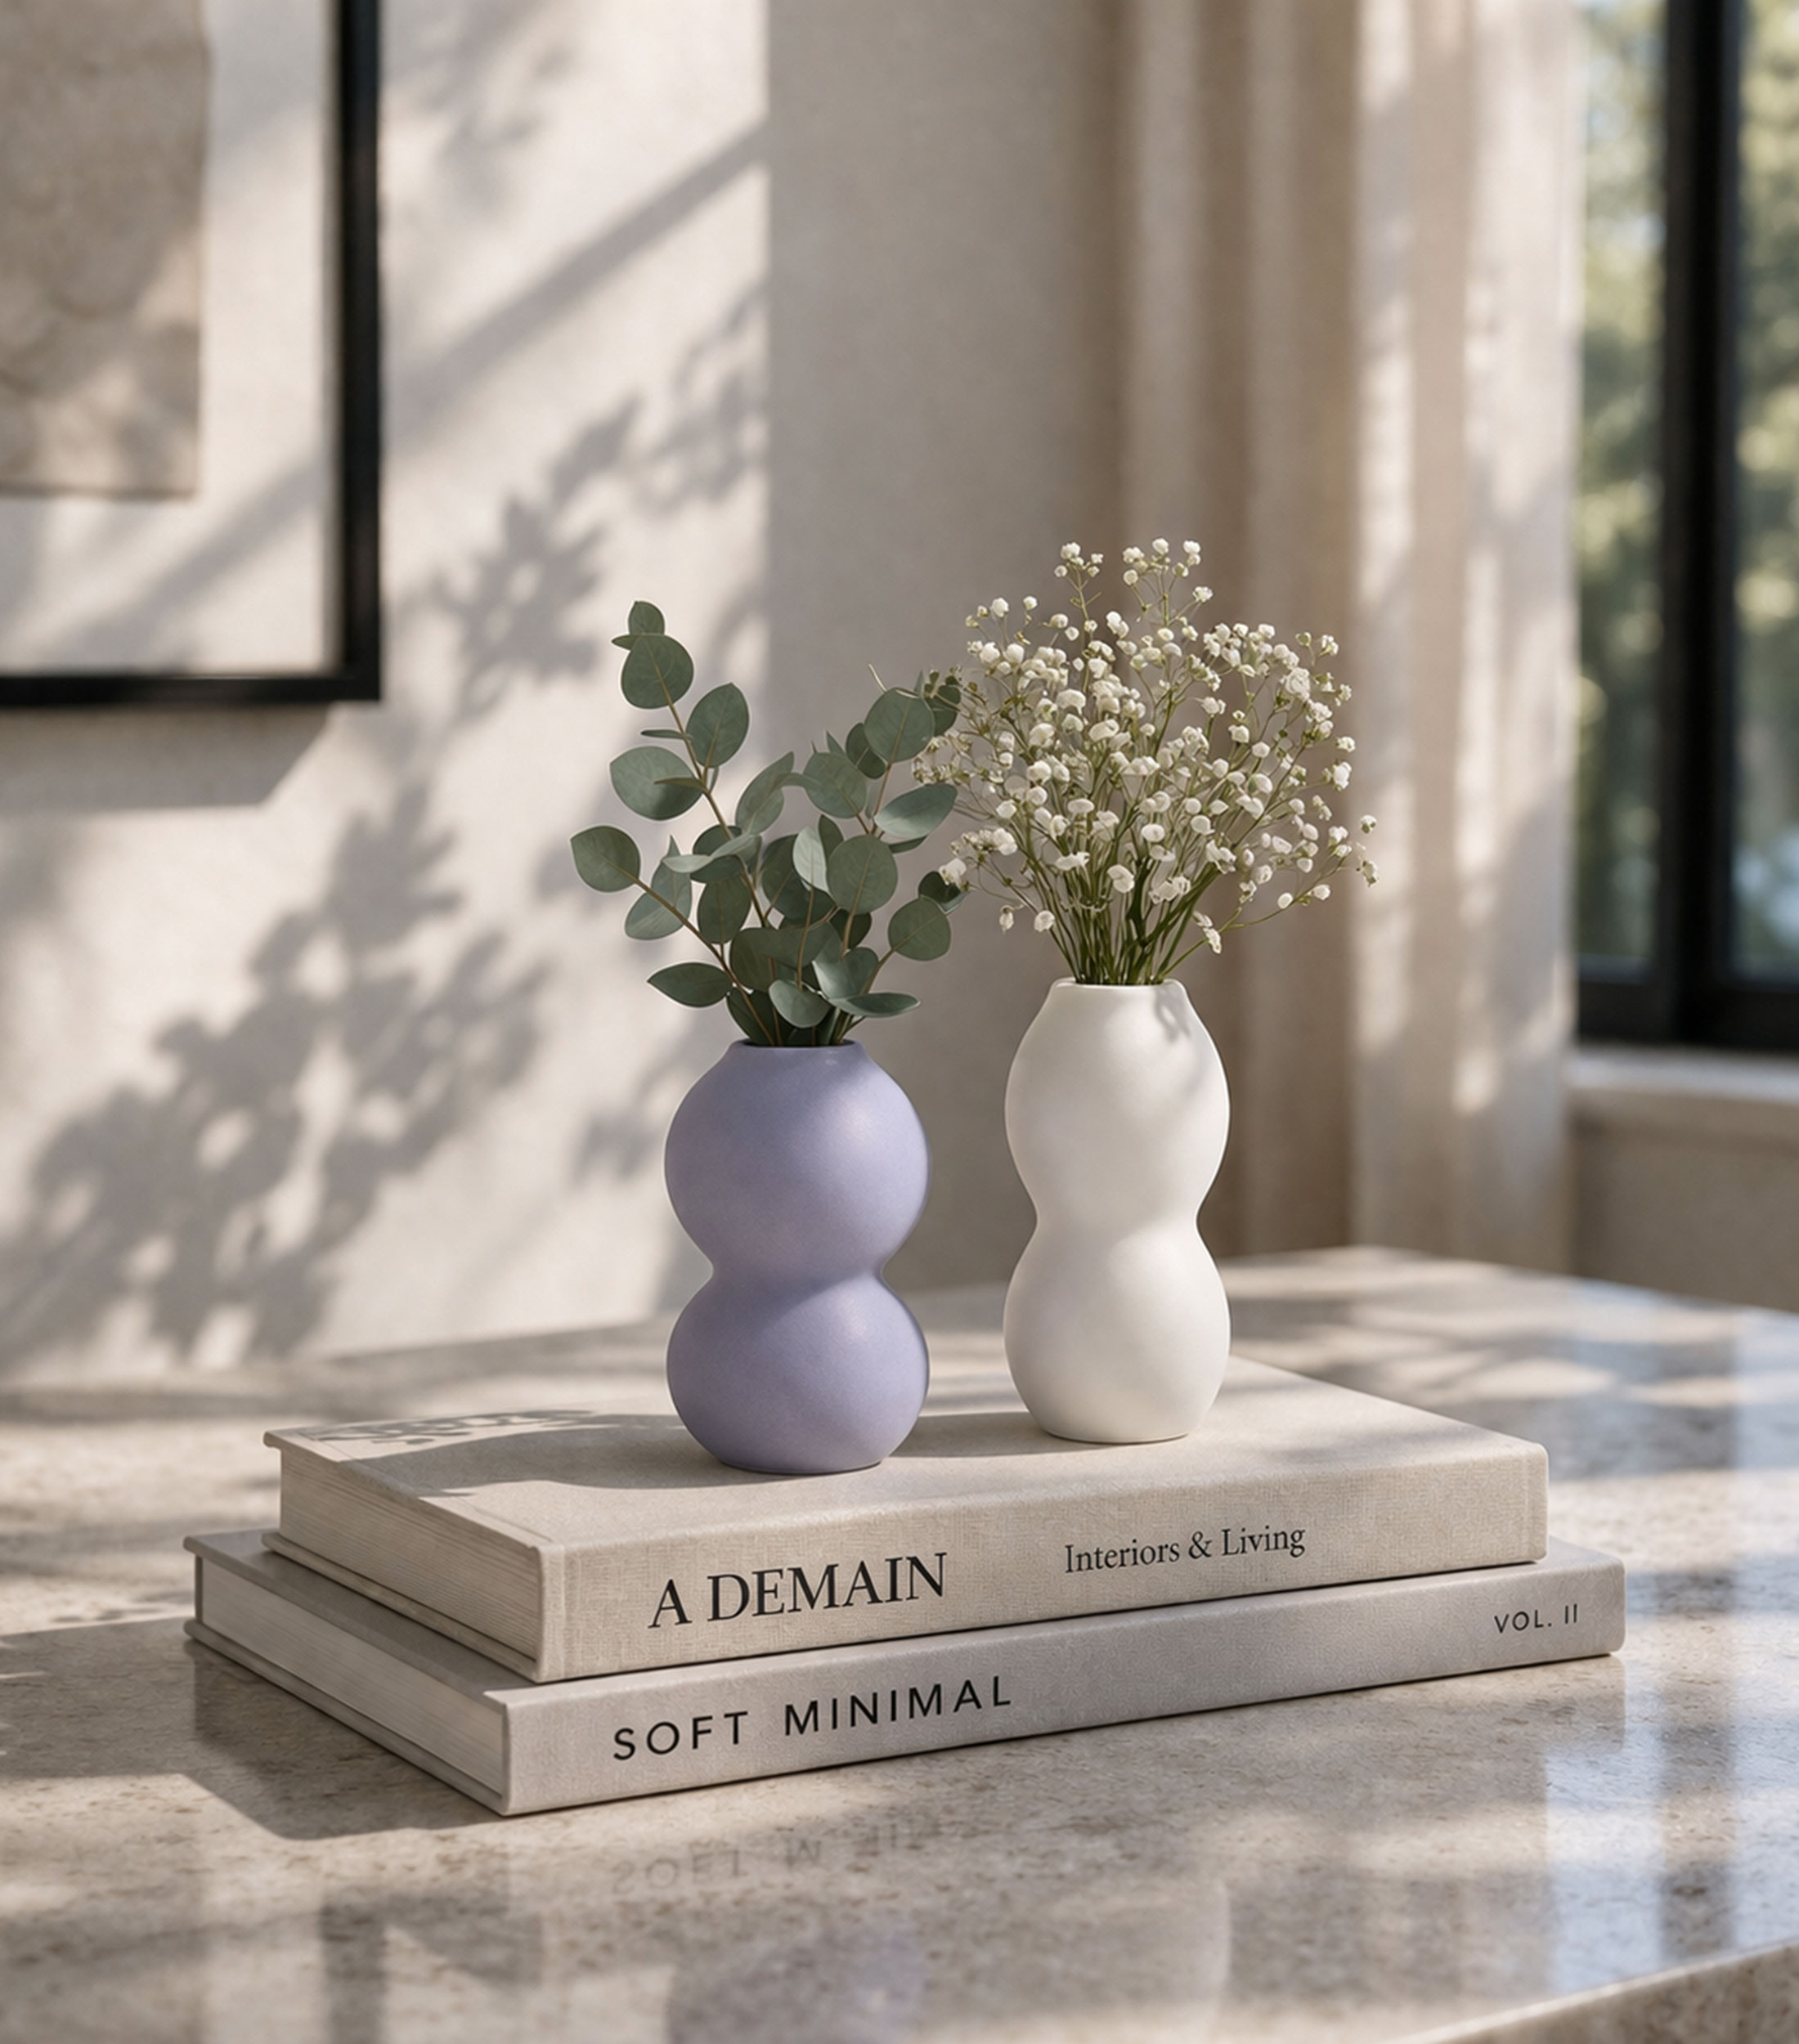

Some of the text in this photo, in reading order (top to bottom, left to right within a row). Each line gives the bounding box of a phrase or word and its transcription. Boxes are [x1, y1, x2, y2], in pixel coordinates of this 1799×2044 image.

[1065, 1525, 1306, 1574] Interiors & Living
[647, 1552, 948, 1629] A DEMAIN
[1493, 1609, 1552, 1634] VOL.
[612, 1675, 1012, 1761] SOFT MINIMAL
